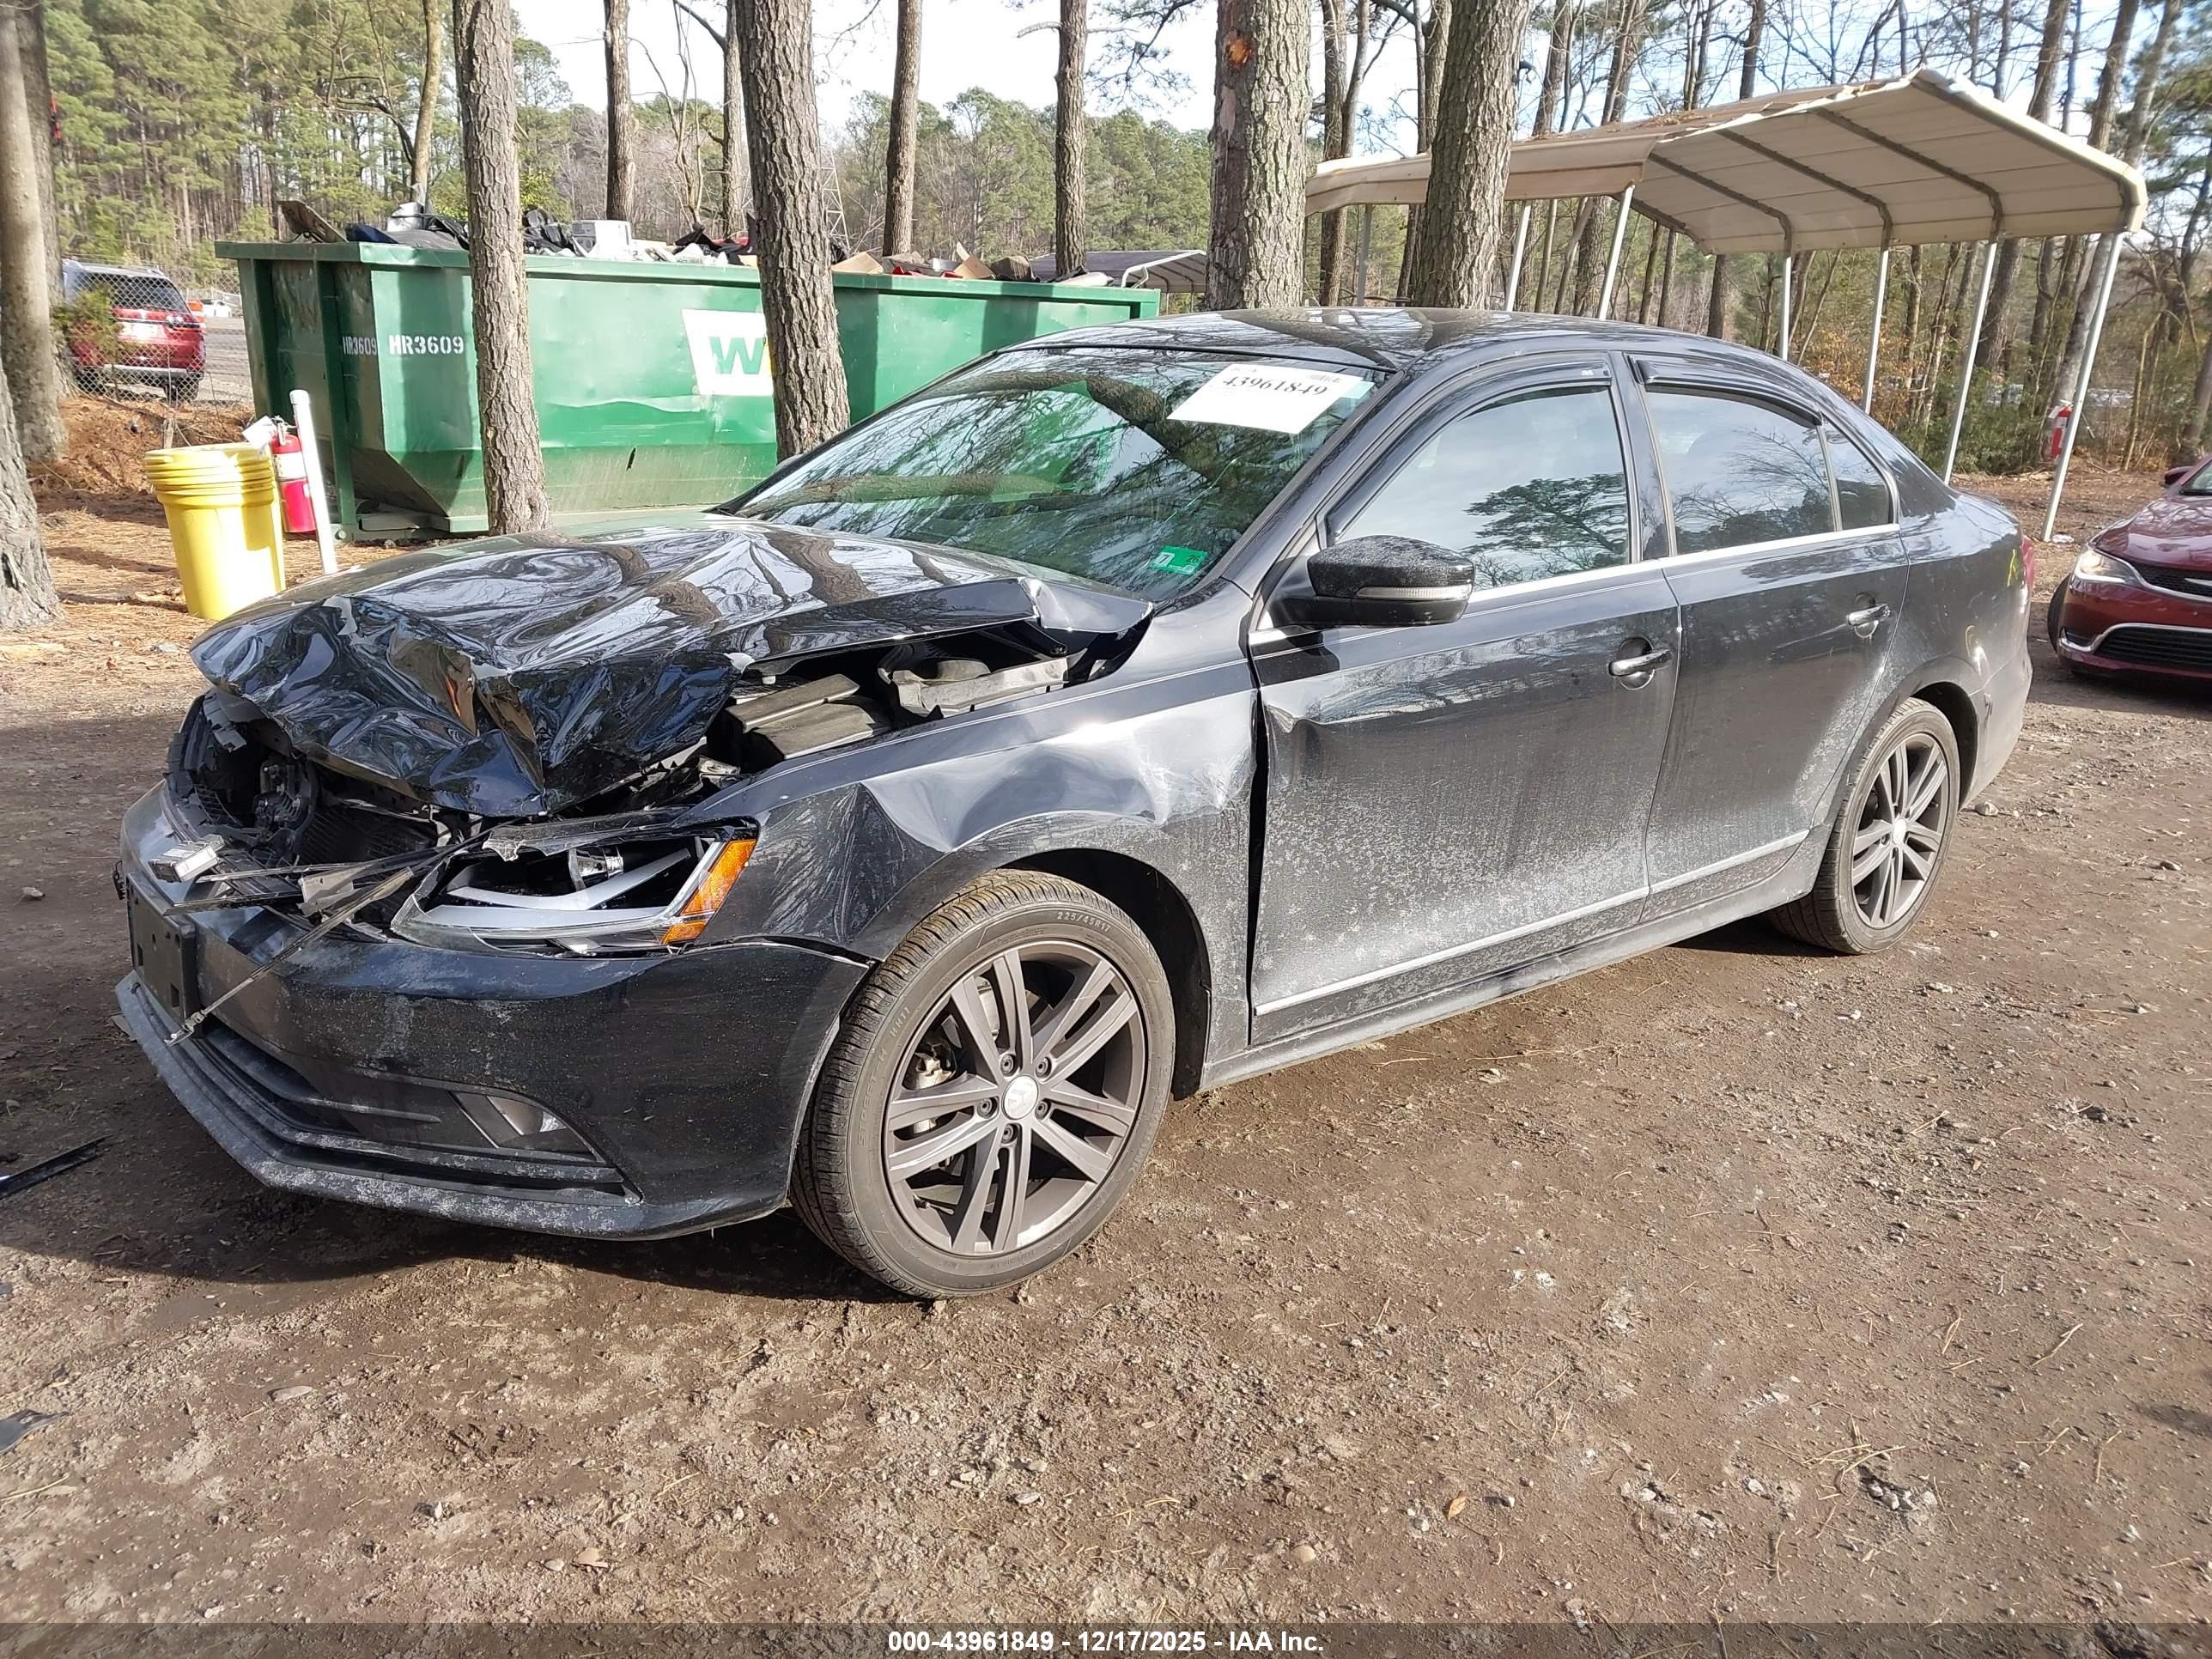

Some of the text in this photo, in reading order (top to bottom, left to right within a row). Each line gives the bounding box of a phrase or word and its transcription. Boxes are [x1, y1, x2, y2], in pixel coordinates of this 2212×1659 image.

[343, 336, 378, 356] HR3609
[388, 335, 464, 355] HR3609
[708, 336, 770, 374] W
[1223, 376, 1328, 395] 43961849
[1057, 911, 1111, 933] 225/45R17
